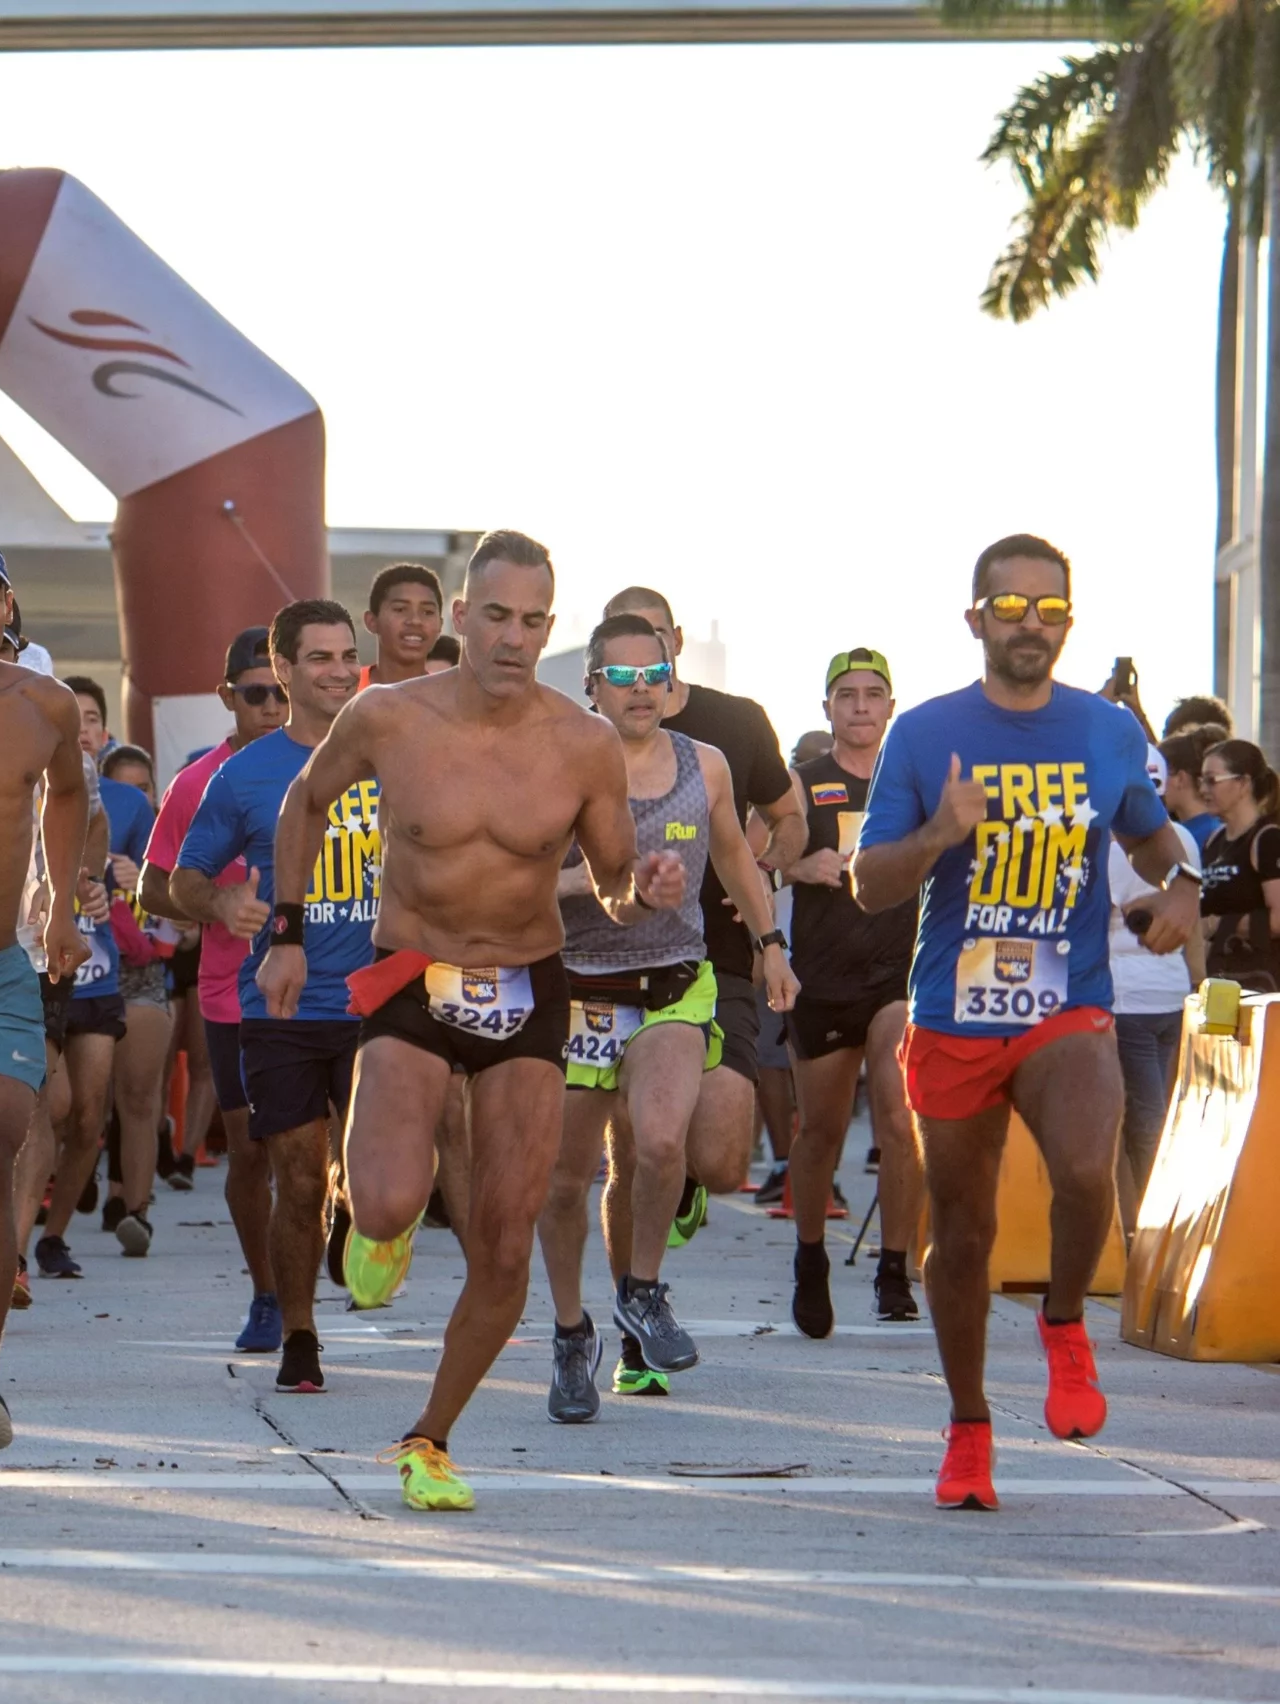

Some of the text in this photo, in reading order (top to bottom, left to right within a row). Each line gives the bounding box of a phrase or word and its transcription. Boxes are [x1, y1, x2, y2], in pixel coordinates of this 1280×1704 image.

[328, 780, 380, 826] EE
[972, 762, 1088, 820] FREE
[665, 821, 697, 841] iRun
[969, 820, 1086, 909] DOM
[964, 903, 1070, 934] FOR ALL
[80, 964, 105, 981] 70
[966, 986, 1059, 1018] 3309
[442, 1003, 525, 1034] 3245
[568, 1033, 624, 1062] 424
